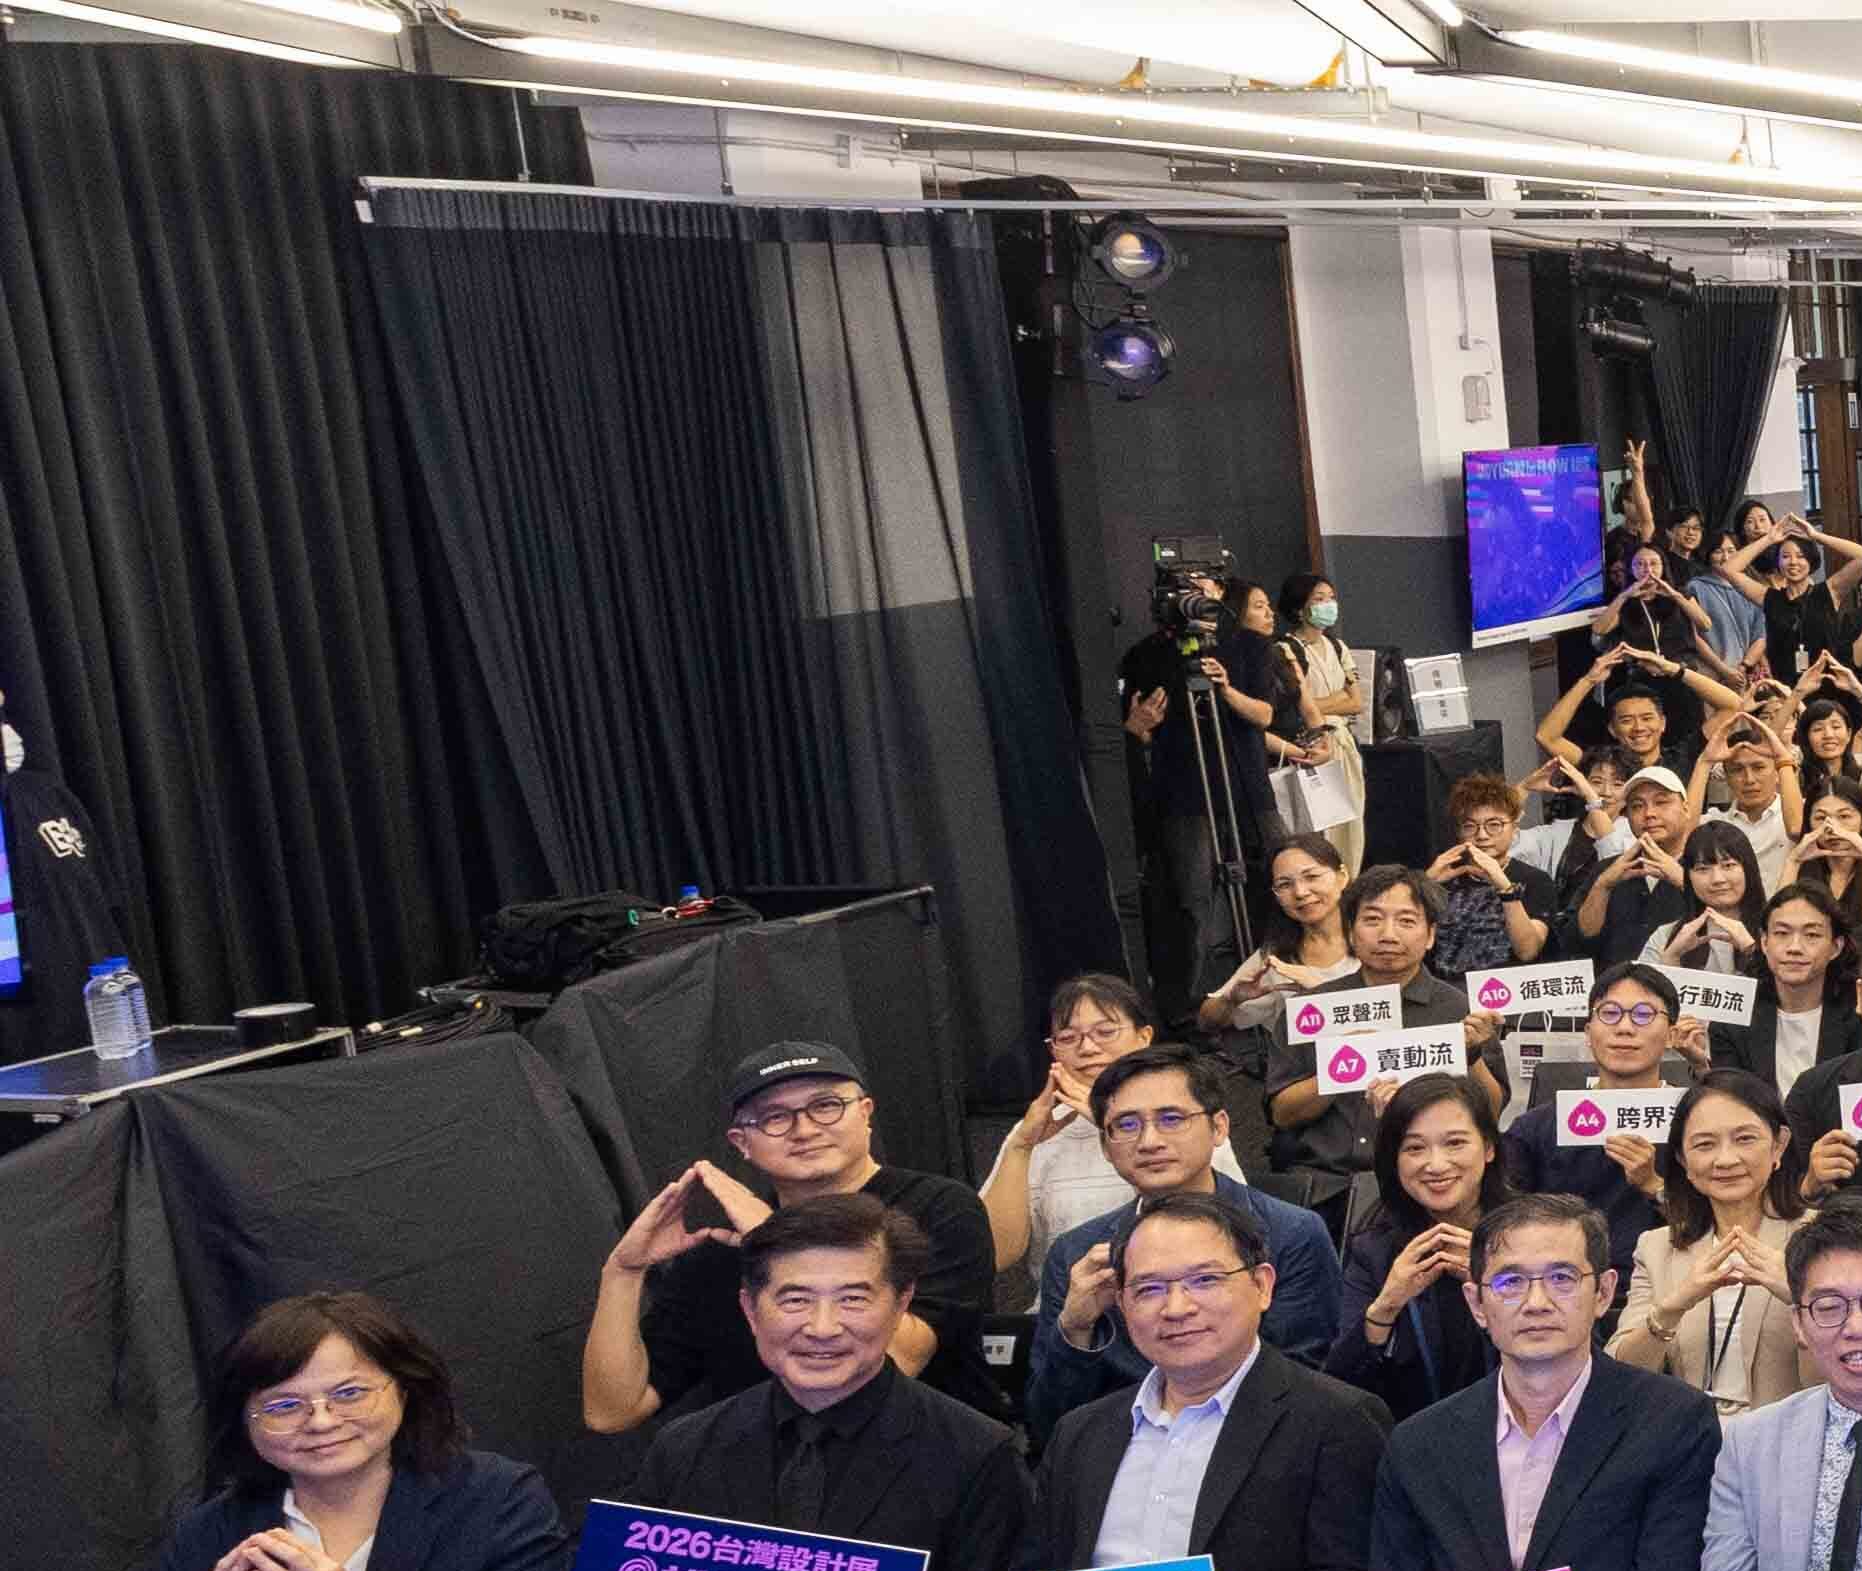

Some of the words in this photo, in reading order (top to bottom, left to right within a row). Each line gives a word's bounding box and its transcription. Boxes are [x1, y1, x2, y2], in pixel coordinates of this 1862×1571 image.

[1482, 989, 1508, 1003] A10
[1519, 975, 1587, 1001] 循環流
[1678, 984, 1745, 1013] 行動流
[1300, 1013, 1321, 1026] A11
[1333, 1000, 1392, 1025] 眾聲流
[1336, 1059, 1360, 1074] A7
[1376, 1042, 1455, 1073] 賣動流
[1575, 1115, 1601, 1128] A4
